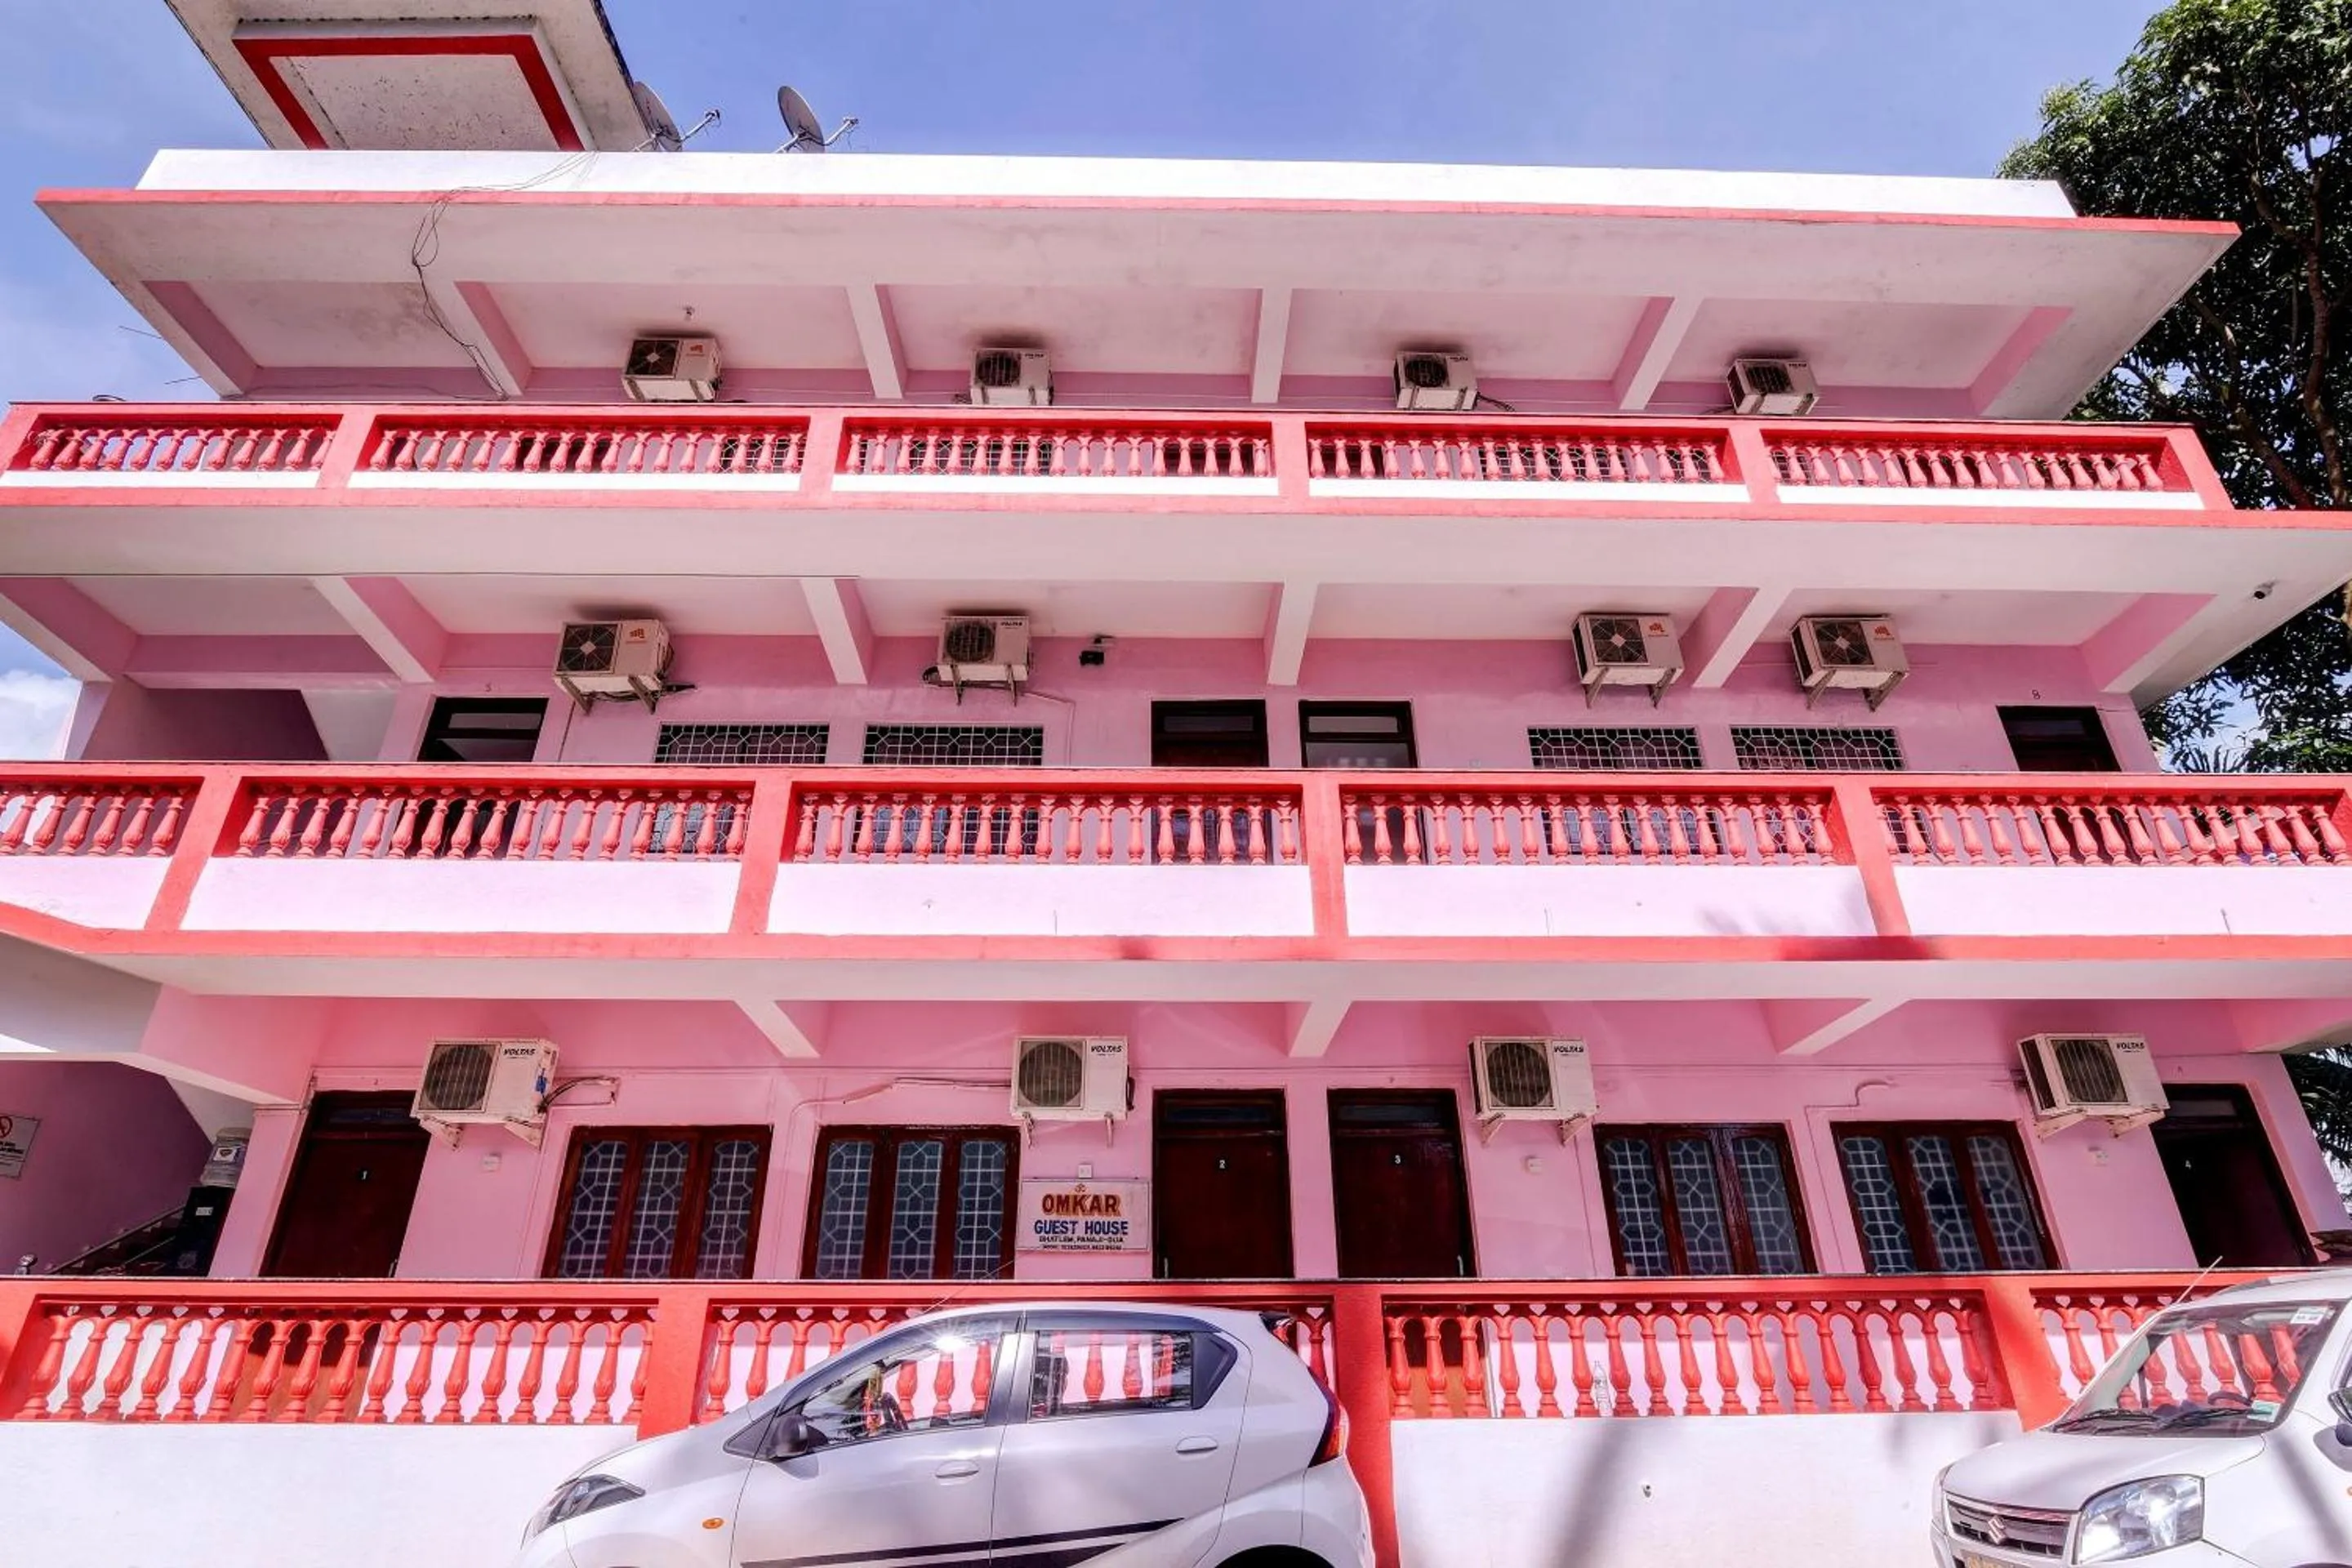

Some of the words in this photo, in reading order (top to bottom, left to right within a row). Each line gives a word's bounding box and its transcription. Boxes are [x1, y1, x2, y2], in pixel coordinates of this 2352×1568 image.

[1219, 1159, 1226, 1169] 2
[1041, 1194, 1121, 1216] OMKAR
[1034, 1219, 1078, 1235] GUEST
[1085, 1220, 1129, 1235] HOUSE
